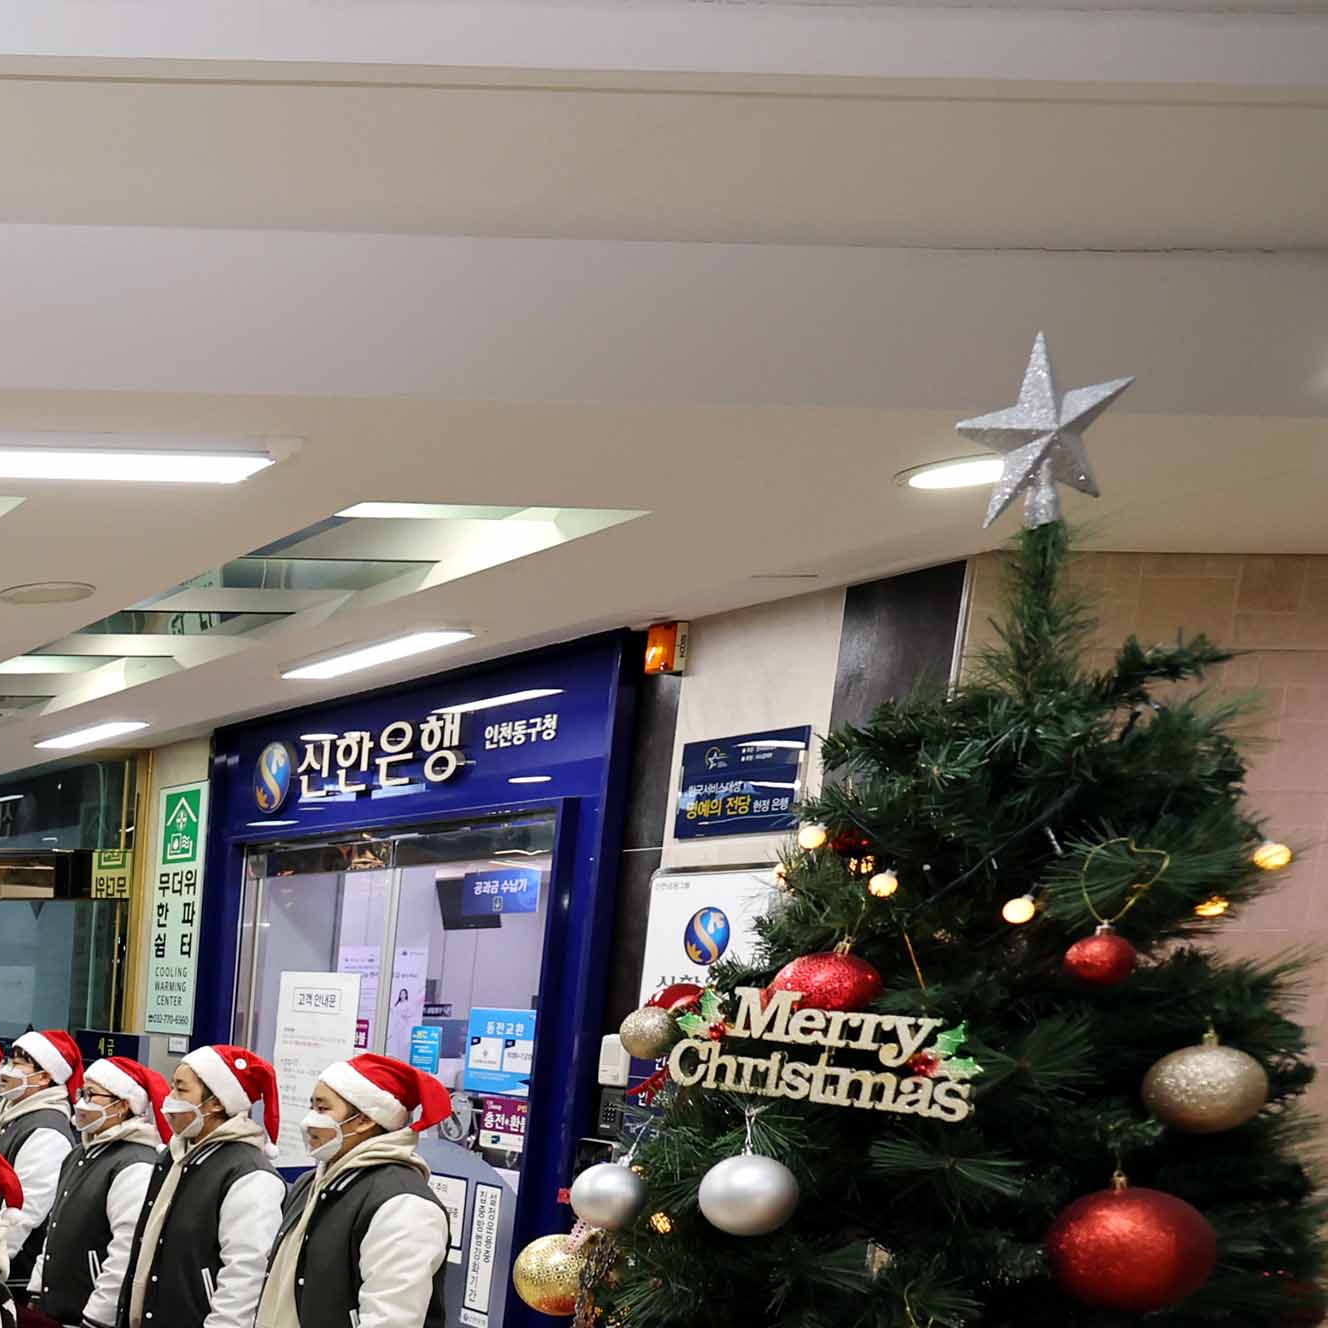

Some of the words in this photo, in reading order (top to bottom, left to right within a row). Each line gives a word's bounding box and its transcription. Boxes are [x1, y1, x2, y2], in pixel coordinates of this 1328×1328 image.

[297, 712, 463, 798] 신한은행
[484, 713, 558, 750] 인천동구청
[686, 799, 722, 820] 명예의
[726, 795, 751, 815] 전당
[753, 799, 770, 813] 헌정
[771, 797, 790, 811] 은행
[158, 869, 198, 897] 무더위
[473, 881, 499, 896] 공과금
[500, 879, 528, 894] 수납기
[155, 967, 188, 978] COOLING
[155, 981, 187, 993] WARMING
[156, 995, 182, 1006] CENTER
[297, 993, 312, 1006] 고객
[314, 993, 336, 1009] 안내문
[486, 1021, 524, 1036] 동전교환
[735, 986, 942, 1067] Merry
[668, 1039, 975, 1123] Christmas
